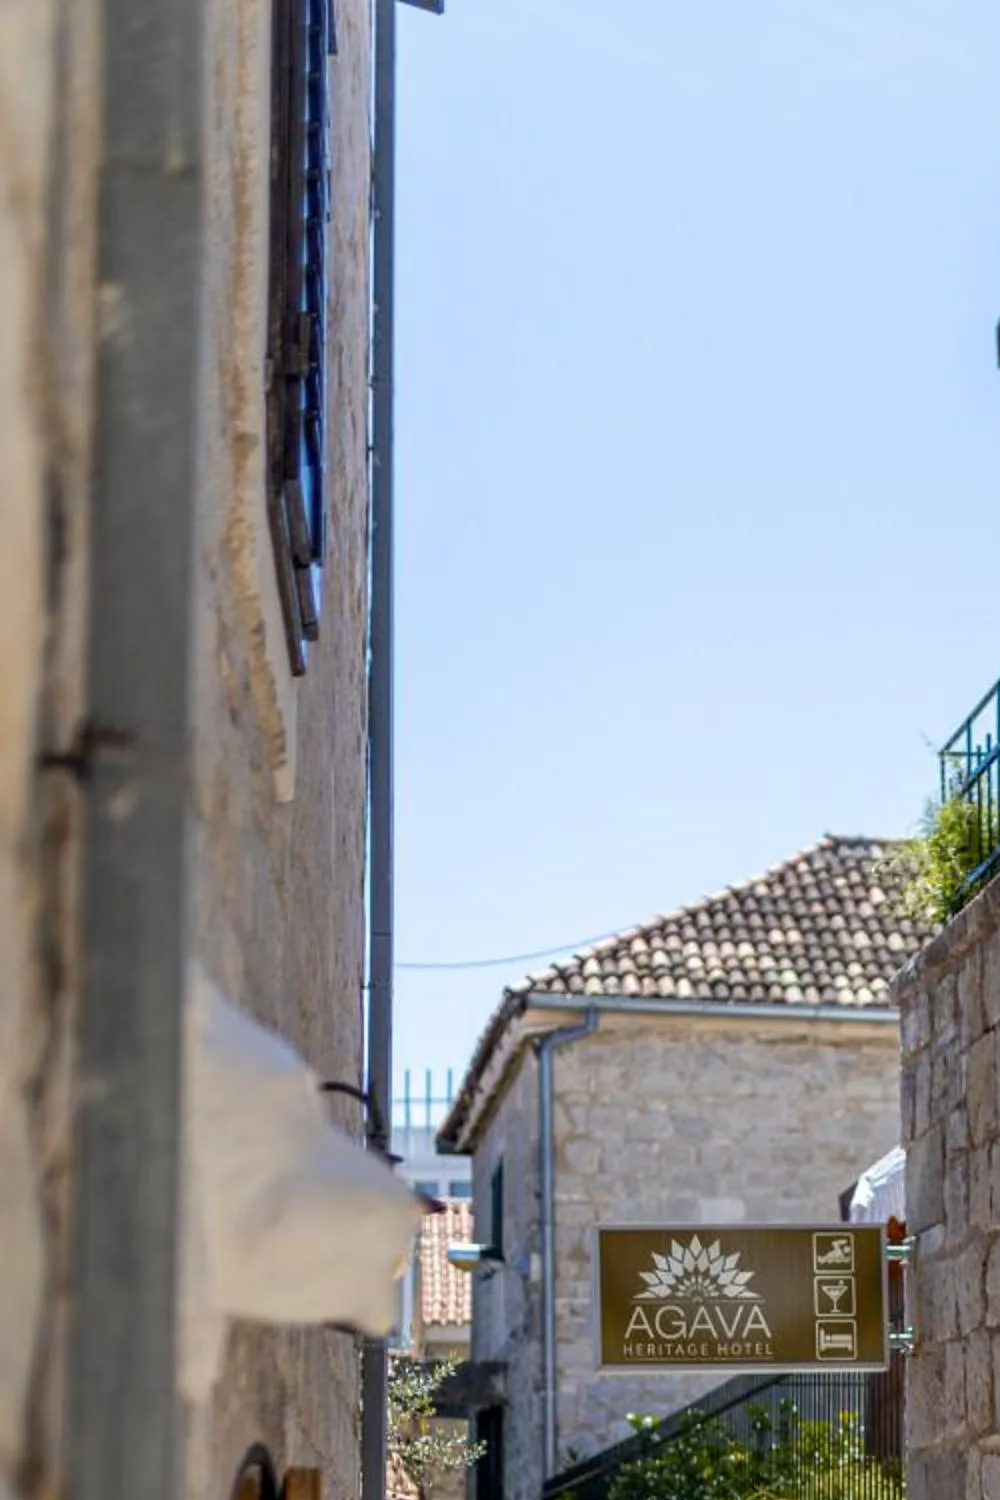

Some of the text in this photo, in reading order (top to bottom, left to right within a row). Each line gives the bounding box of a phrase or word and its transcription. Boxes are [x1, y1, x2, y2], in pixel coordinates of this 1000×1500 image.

[625, 1305, 772, 1340] AGAVA
[624, 1342, 773, 1357] HERITAGE HOTEL
